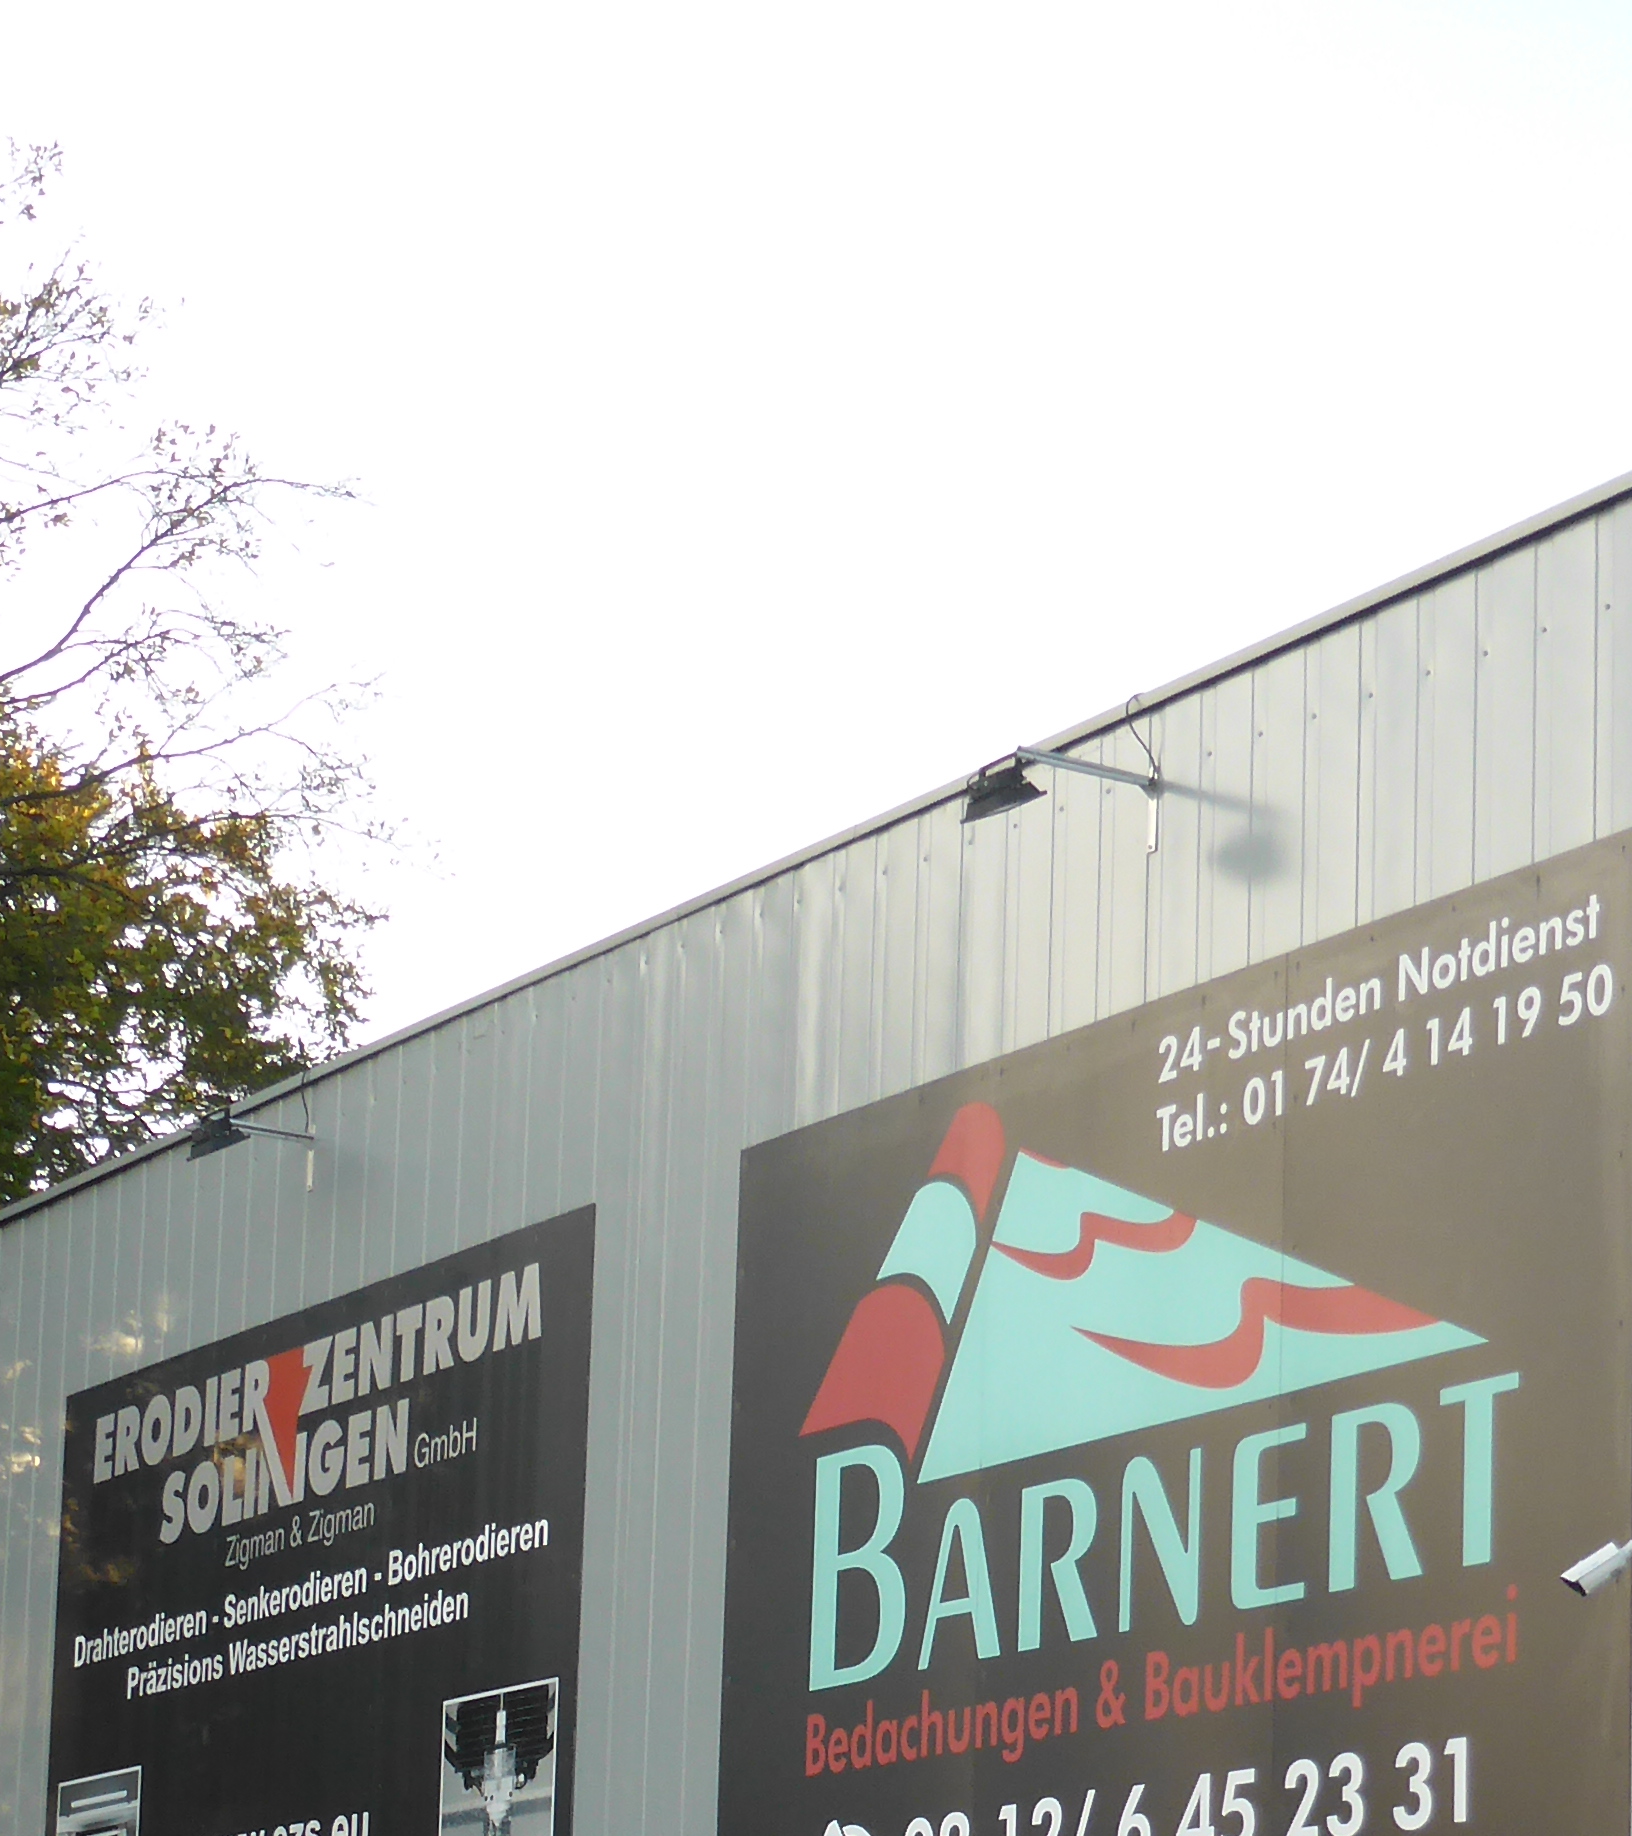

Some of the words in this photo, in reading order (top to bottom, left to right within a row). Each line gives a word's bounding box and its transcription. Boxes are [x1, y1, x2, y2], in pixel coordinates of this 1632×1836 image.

[1157, 1093, 1228, 1152] Tel.:
[1243, 1070, 1284, 1126] 01
[1382, 1028, 1407, 1077] 4
[1426, 1007, 1473, 1066] 14
[1493, 986, 1541, 1046] 19
[1558, 964, 1614, 1027] 50
[1158, 977, 1380, 1084] 24-Stunden
[1397, 894, 1600, 1001] Notdienst
[298, 1263, 541, 1417] ZENTRUM
[159, 1398, 409, 1544] SOLINGEN
[414, 1417, 477, 1469] GmbH
[225, 1525, 285, 1570] Zigman
[290, 1518, 303, 1547] &
[308, 1502, 375, 1549] Zigman
[74, 1605, 207, 1668] Drahterodieren
[223, 1565, 368, 1628] Senkerodieren
[388, 1518, 549, 1586] Bohrerodieren
[127, 1651, 223, 1699] Präzisions
[229, 1590, 469, 1676] Wasserstrahlschneiden
[805, 1688, 1079, 1777] Bedachungen
[1095, 1659, 1127, 1729] &
[1143, 1584, 1519, 1719] Bauklempnerei
[1393, 1736, 1471, 1832] 31
